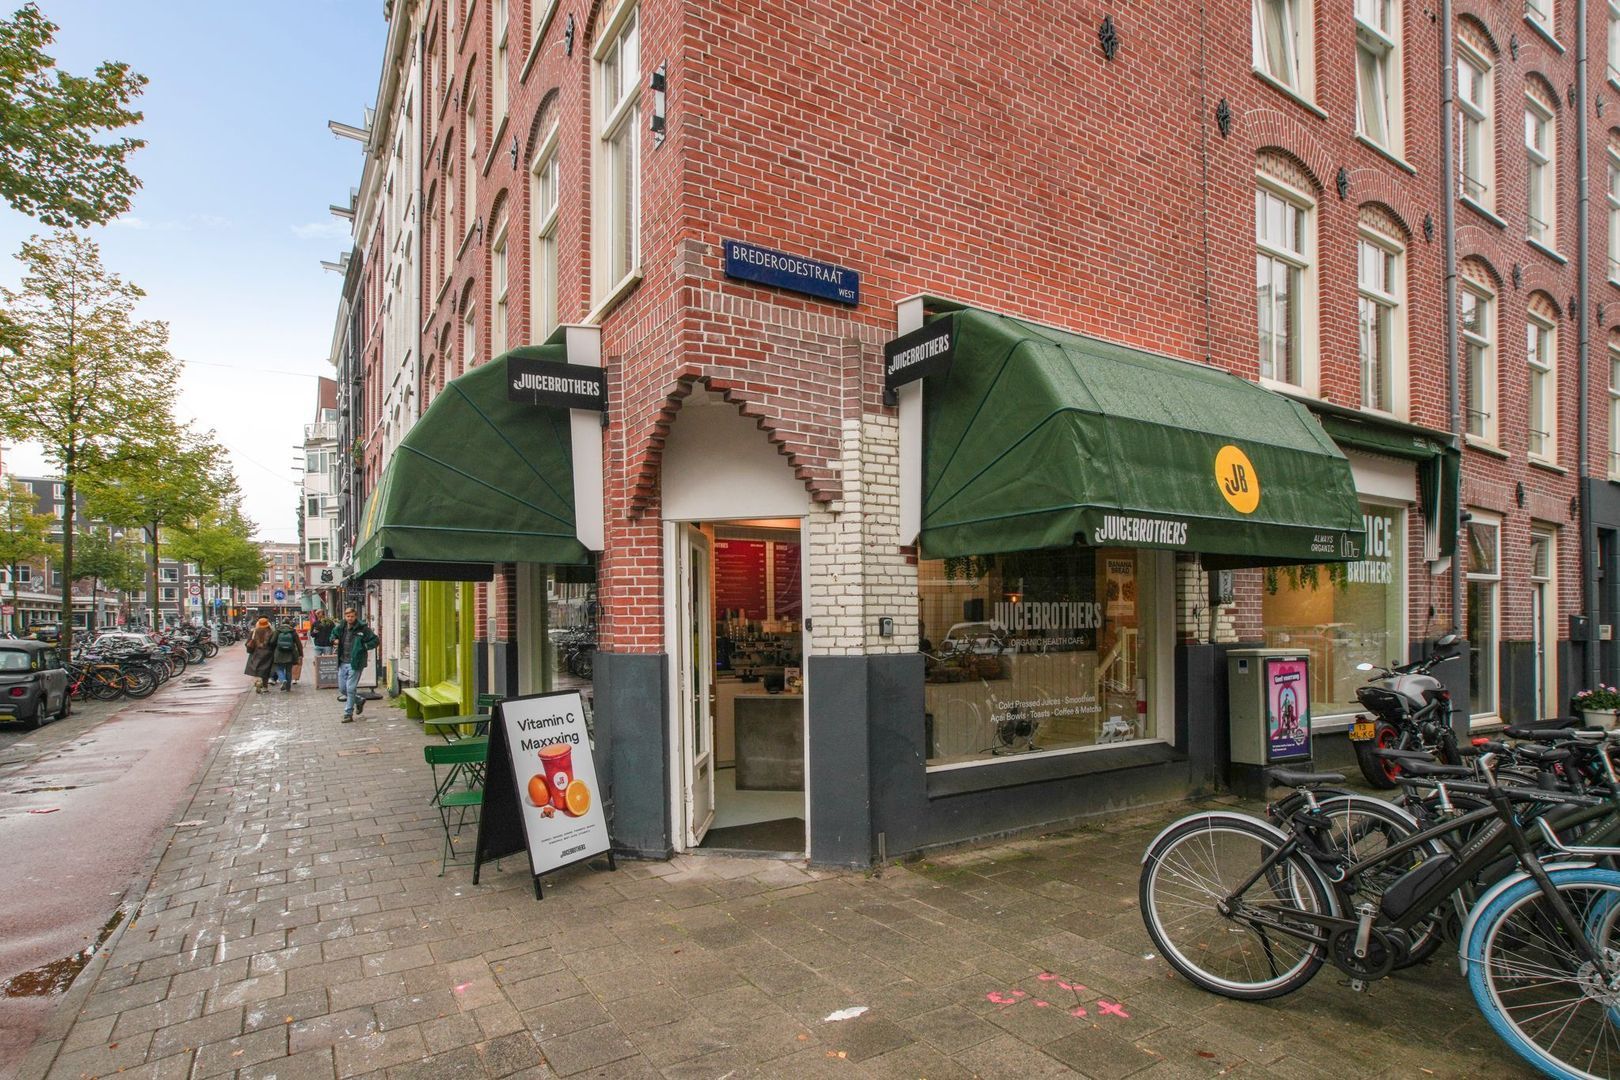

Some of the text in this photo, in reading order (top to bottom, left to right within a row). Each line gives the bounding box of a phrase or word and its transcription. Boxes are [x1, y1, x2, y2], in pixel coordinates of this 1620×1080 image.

[733, 245, 843, 285] BREDERODESTRAAT
[838, 287, 855, 299] WEST
[891, 334, 950, 373] JUICEBROTHERS
[518, 373, 600, 396] JUICEBROTHERS
[1229, 464, 1249, 494] JB
[1099, 515, 1188, 545] JUICEBROTHERS
[1313, 534, 1334, 544] ALWAYS
[1363, 514, 1392, 557] ICE
[1310, 543, 1335, 553] ORGANIC
[1347, 560, 1393, 584] BROTHERS
[989, 602, 1102, 631] JUICEBROTHERS
[1010, 638, 1042, 647] ORGANIC
[1042, 637, 1067, 646] HEALTH
[998, 694, 1096, 710] Cold Pressed Juices Smoothies
[1006, 711, 1027, 721] Bowls
[1030, 709, 1050, 719] Toasts
[1054, 707, 1074, 716] Coffee
[1080, 704, 1102, 713] Matcha
[517, 712, 575, 731] Vitamin C
[521, 731, 580, 751] Maxxxing
